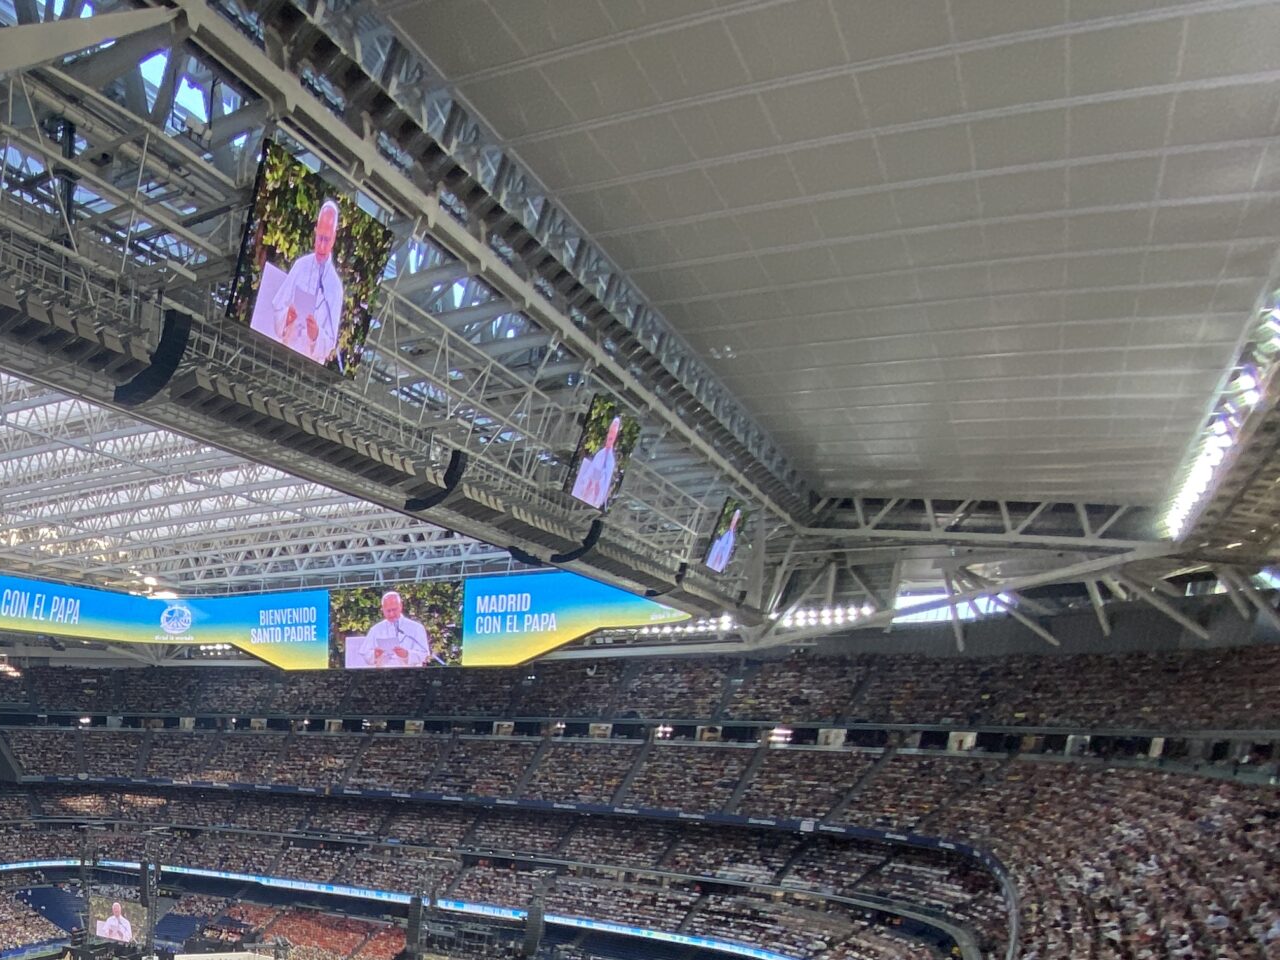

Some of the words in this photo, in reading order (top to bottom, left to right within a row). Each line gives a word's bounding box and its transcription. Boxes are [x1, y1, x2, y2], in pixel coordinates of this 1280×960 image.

[1, 589, 29, 618] CON
[32, 594, 45, 621] EL
[49, 596, 80, 625] PAPA
[476, 593, 531, 614] MADRID
[259, 606, 317, 626] BIENVENIDO
[475, 615, 501, 634] CON
[506, 614, 520, 633] EL
[523, 612, 557, 633] PAPA
[250, 626, 282, 645] SANTO
[283, 625, 317, 642] PADRE
